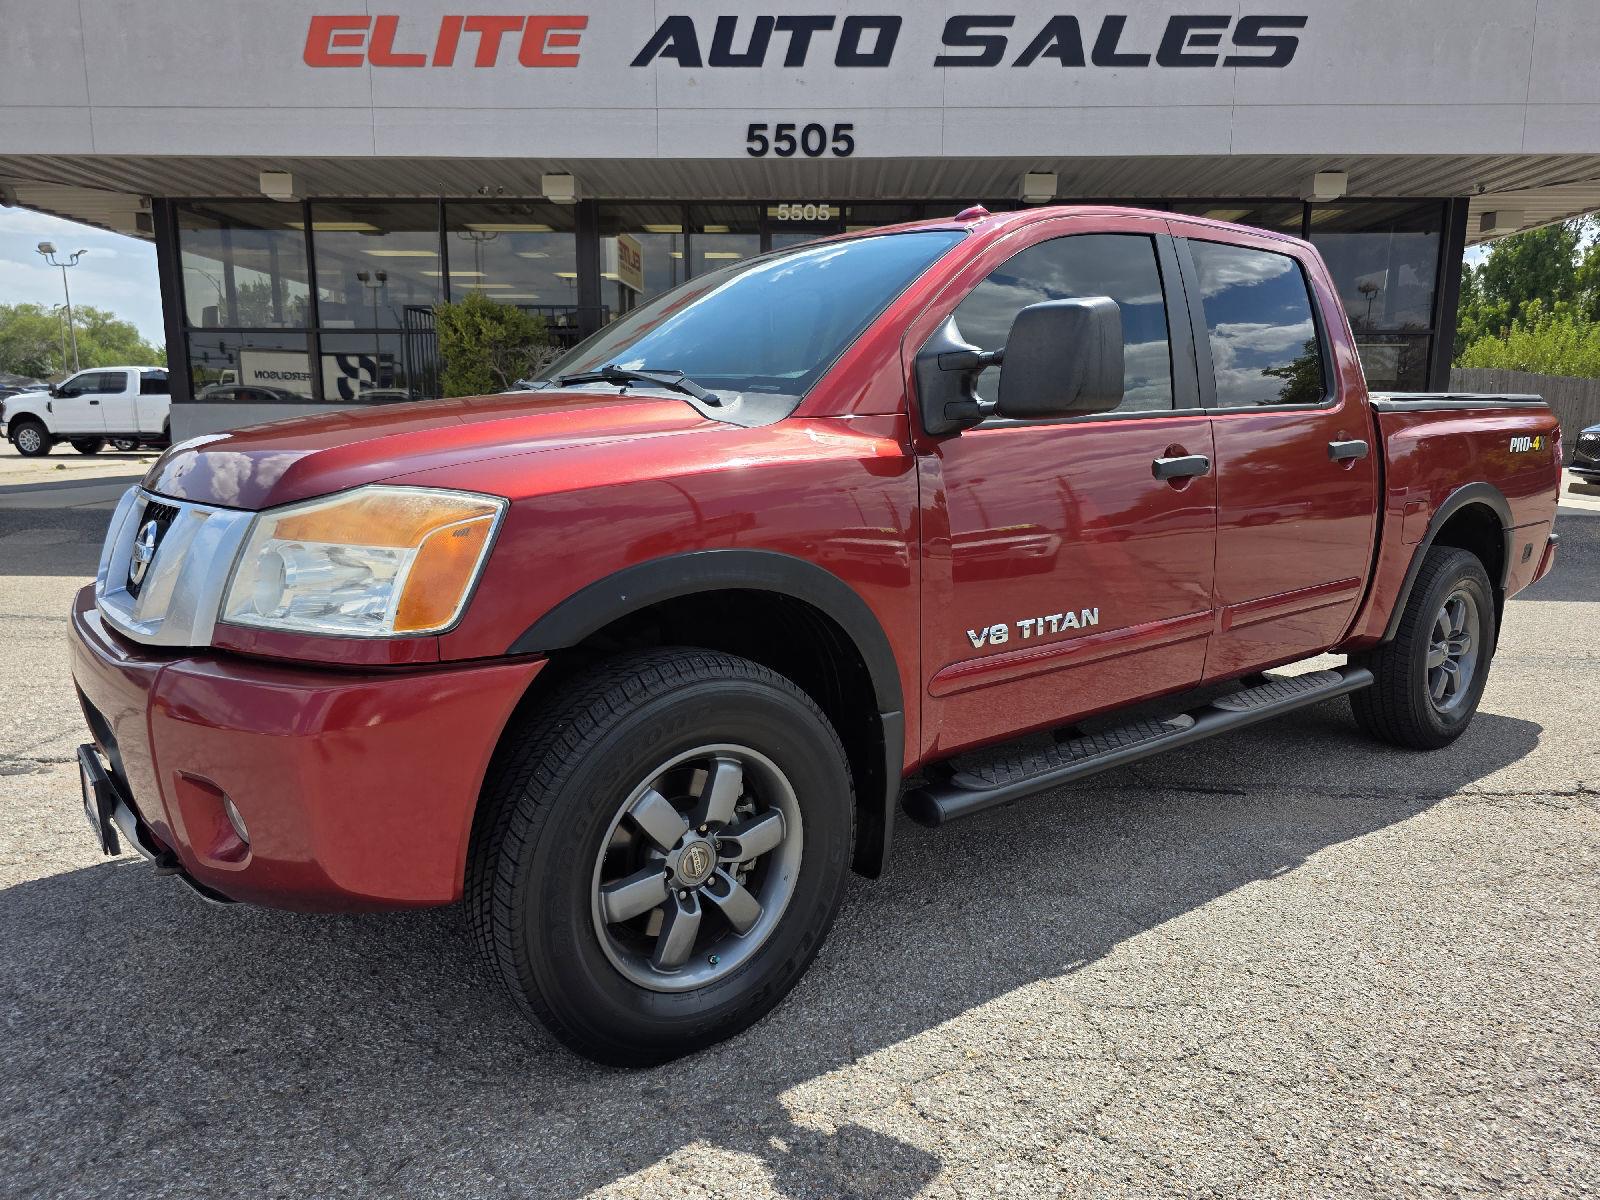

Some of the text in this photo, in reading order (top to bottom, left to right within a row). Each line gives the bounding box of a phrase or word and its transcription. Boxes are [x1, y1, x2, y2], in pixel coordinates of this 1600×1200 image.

[303, 15, 1309, 68] ELITE AUTO SALES
[746, 123, 855, 158] 5505
[777, 204, 831, 221] 5505
[1509, 435, 1547, 453] PRO-4X
[966, 607, 1099, 649] V8 TITAN
